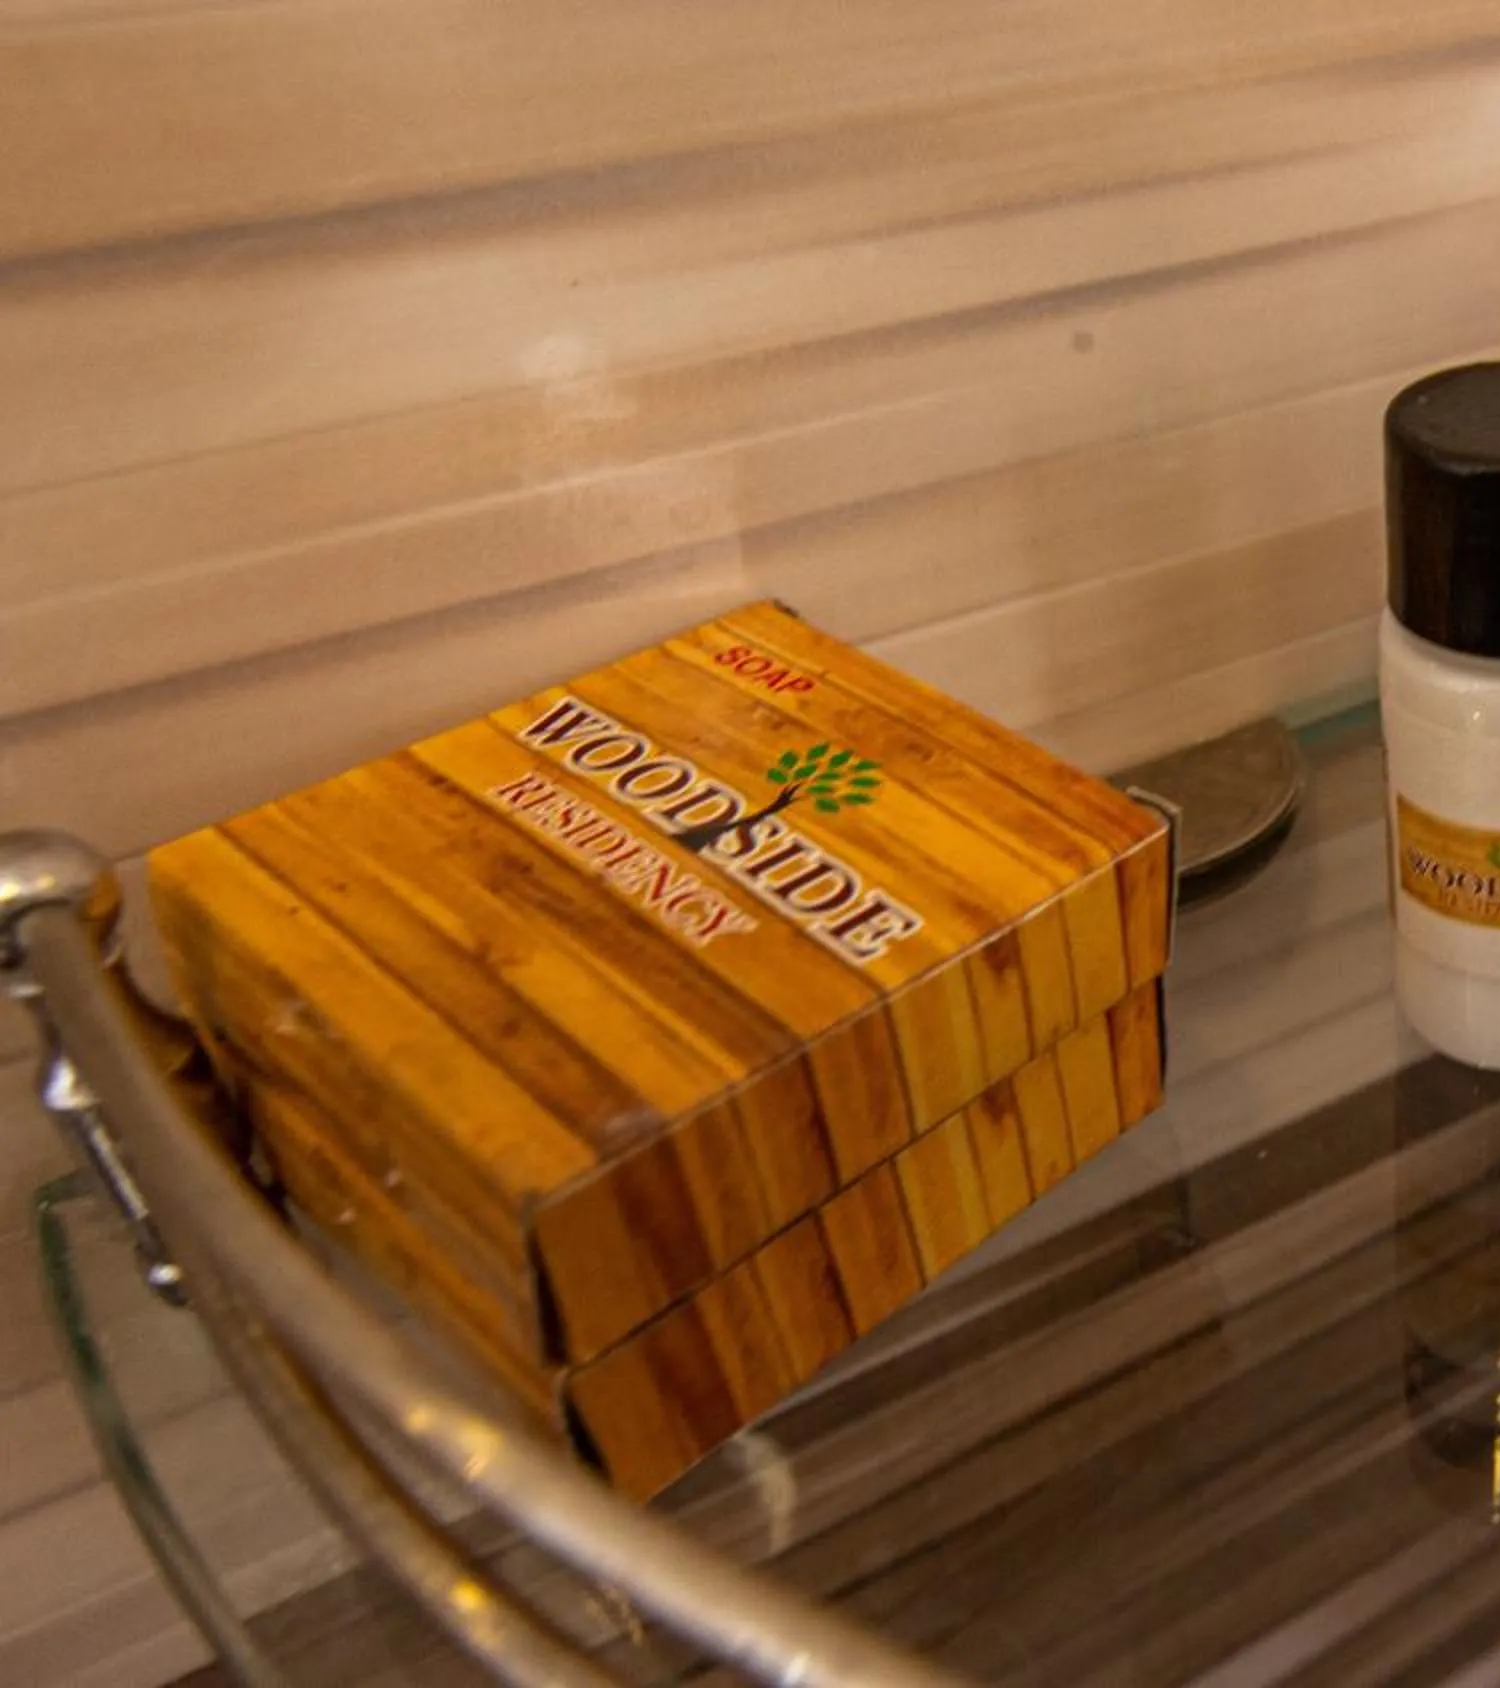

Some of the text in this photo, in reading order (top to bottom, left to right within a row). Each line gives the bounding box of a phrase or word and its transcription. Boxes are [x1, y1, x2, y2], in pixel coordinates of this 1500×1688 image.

[713, 645, 816, 695] SOAP
[492, 773, 757, 946] RESIDENCY
[520, 696, 922, 962] WOODSIDE
